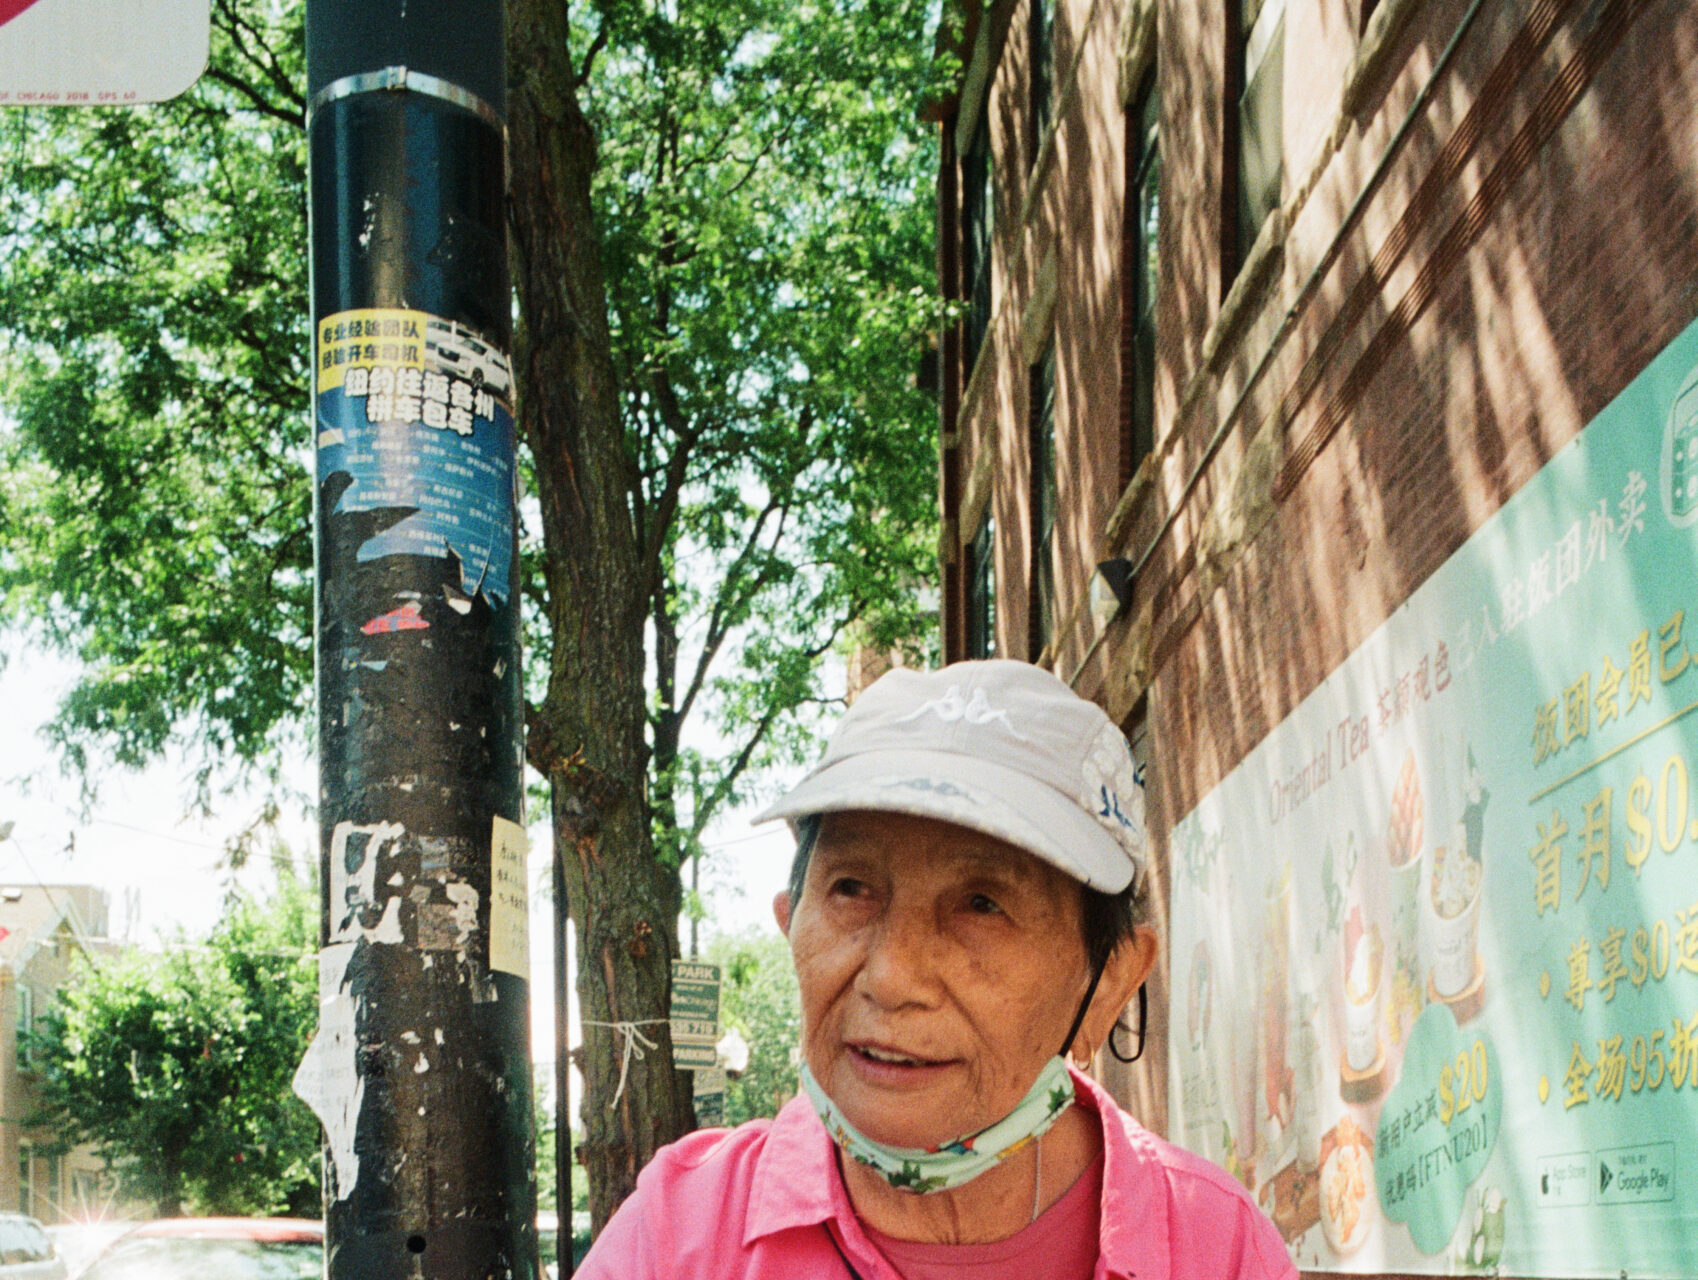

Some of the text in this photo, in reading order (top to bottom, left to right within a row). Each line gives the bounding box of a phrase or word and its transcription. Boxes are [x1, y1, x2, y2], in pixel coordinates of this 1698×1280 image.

[17, 91, 60, 100] CHICAGO
[344, 366, 495, 423] 纽约往返各州
[366, 394, 474, 436] 拼车包车
[1532, 610, 1698, 768] 饭团会员已
[1337, 714, 1370, 771] Tea
[1617, 1167, 1670, 1195] Google Play
